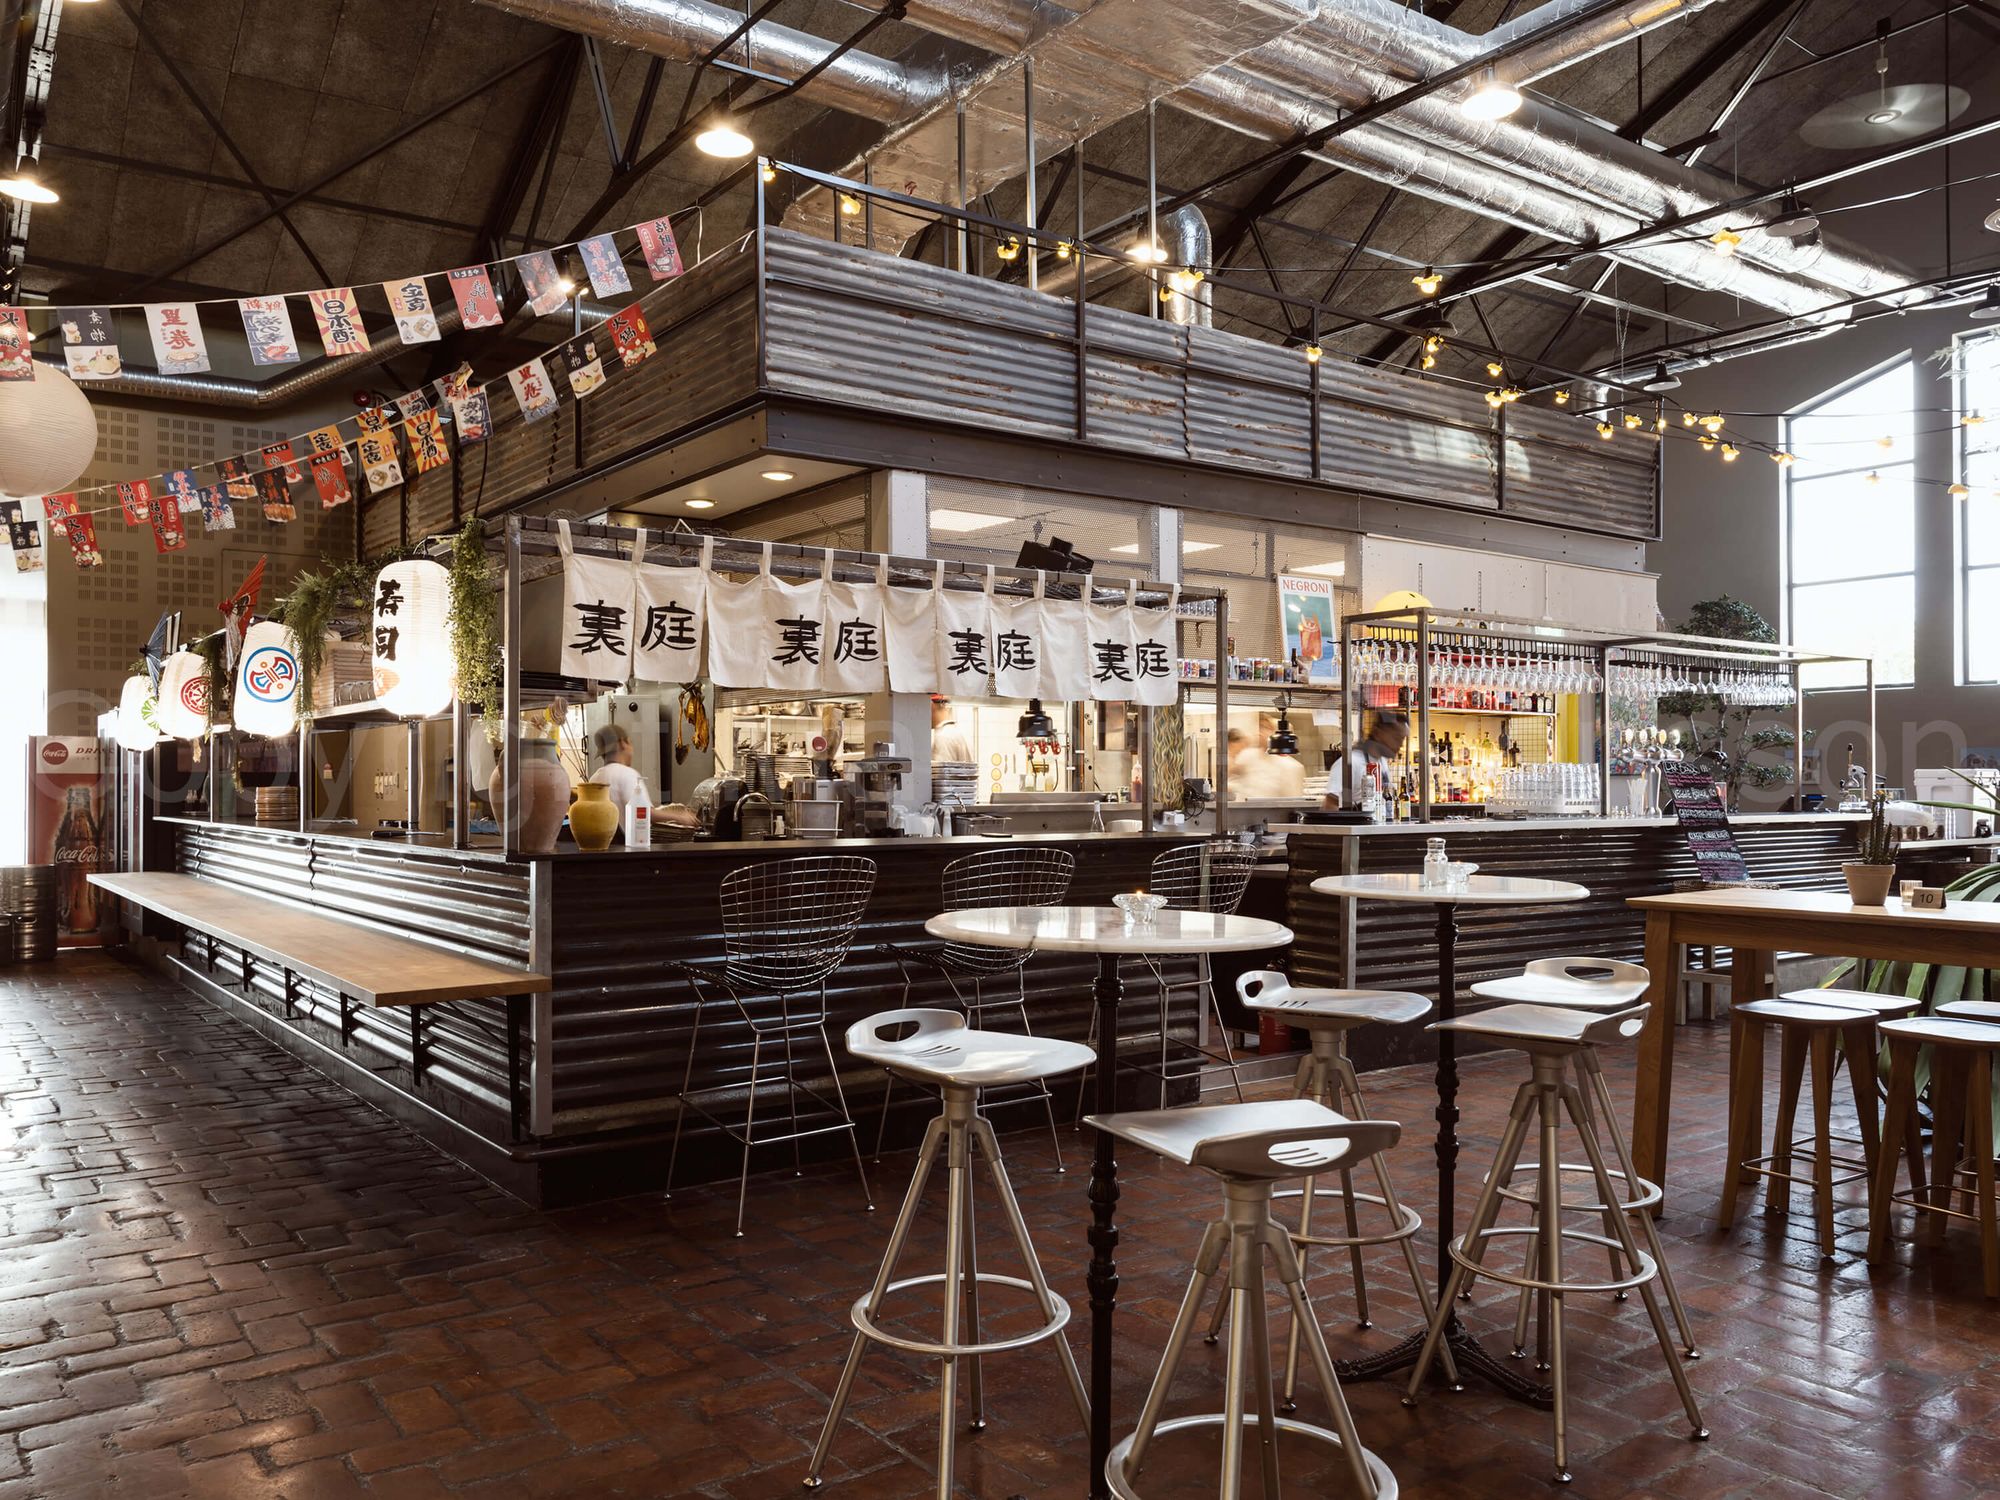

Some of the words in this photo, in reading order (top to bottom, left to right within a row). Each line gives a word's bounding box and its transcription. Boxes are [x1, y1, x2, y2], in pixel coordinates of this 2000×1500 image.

[416, 422, 437, 460] 日本酒
[1282, 579, 1329, 594] NEGRONI
[570, 599, 697, 658] 裏庭
[772, 614, 880, 666] 裏庭
[947, 627, 1036, 675] 裏庭
[1093, 638, 1170, 683] 裏庭
[1920, 894, 1934, 904] 10
